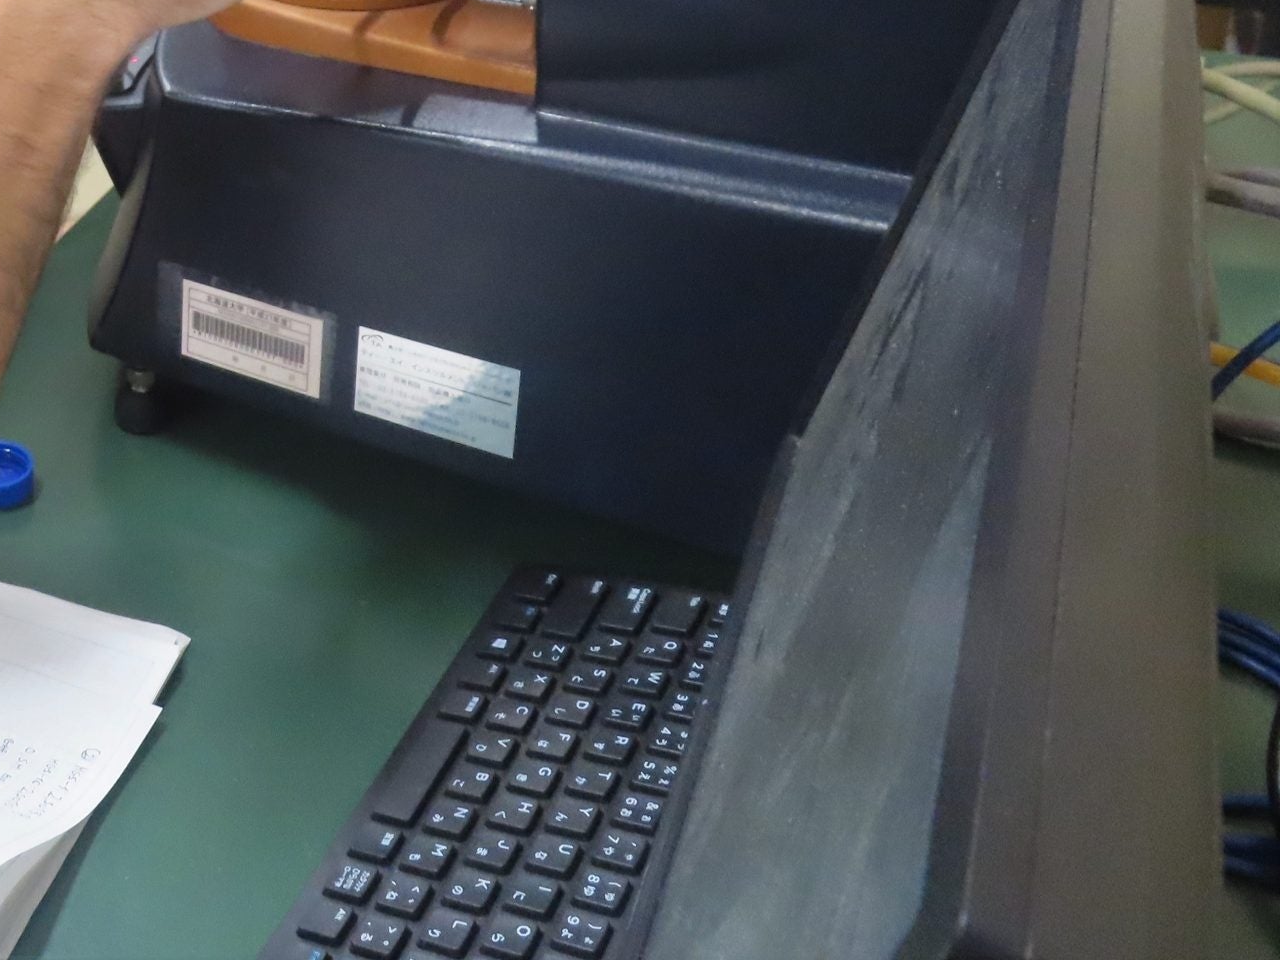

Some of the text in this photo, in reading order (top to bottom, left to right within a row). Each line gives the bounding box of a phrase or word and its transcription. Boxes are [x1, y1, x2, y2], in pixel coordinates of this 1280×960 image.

[610, 638, 622, 646] A
[664, 642, 678, 650] Q
[552, 644, 566, 654] Z
[692, 662, 704, 670] 2
[534, 674, 548, 684] X
[594, 670, 606, 678] S
[648, 672, 663, 684] W
[676, 694, 689, 702] 3
[576, 700, 590, 710] D
[632, 703, 646, 712] E
[516, 706, 529, 716] C
[660, 727, 672, 735] 4
[560, 733, 571, 742] F
[614, 736, 630, 746] R
[498, 739, 511, 748] V
[644, 762, 656, 770] 5
[538, 767, 552, 776] G
[598, 772, 612, 781] T
[476, 772, 490, 782] B
[626, 797, 638, 806] 6
[454, 807, 469, 818] N
[518, 801, 534, 814] H
[495, 811, 506, 819] く
[555, 812, 568, 822] ん
[580, 808, 594, 818] Y
[608, 835, 620, 844] 7
[498, 840, 510, 850] J
[558, 844, 574, 856] U
[432, 844, 448, 857] M
[475, 878, 491, 890] K
[588, 874, 600, 884] 8
[452, 886, 464, 896] の
[452, 920, 468, 928] L
[568, 916, 580, 926] 9
[516, 926, 531, 937] O
